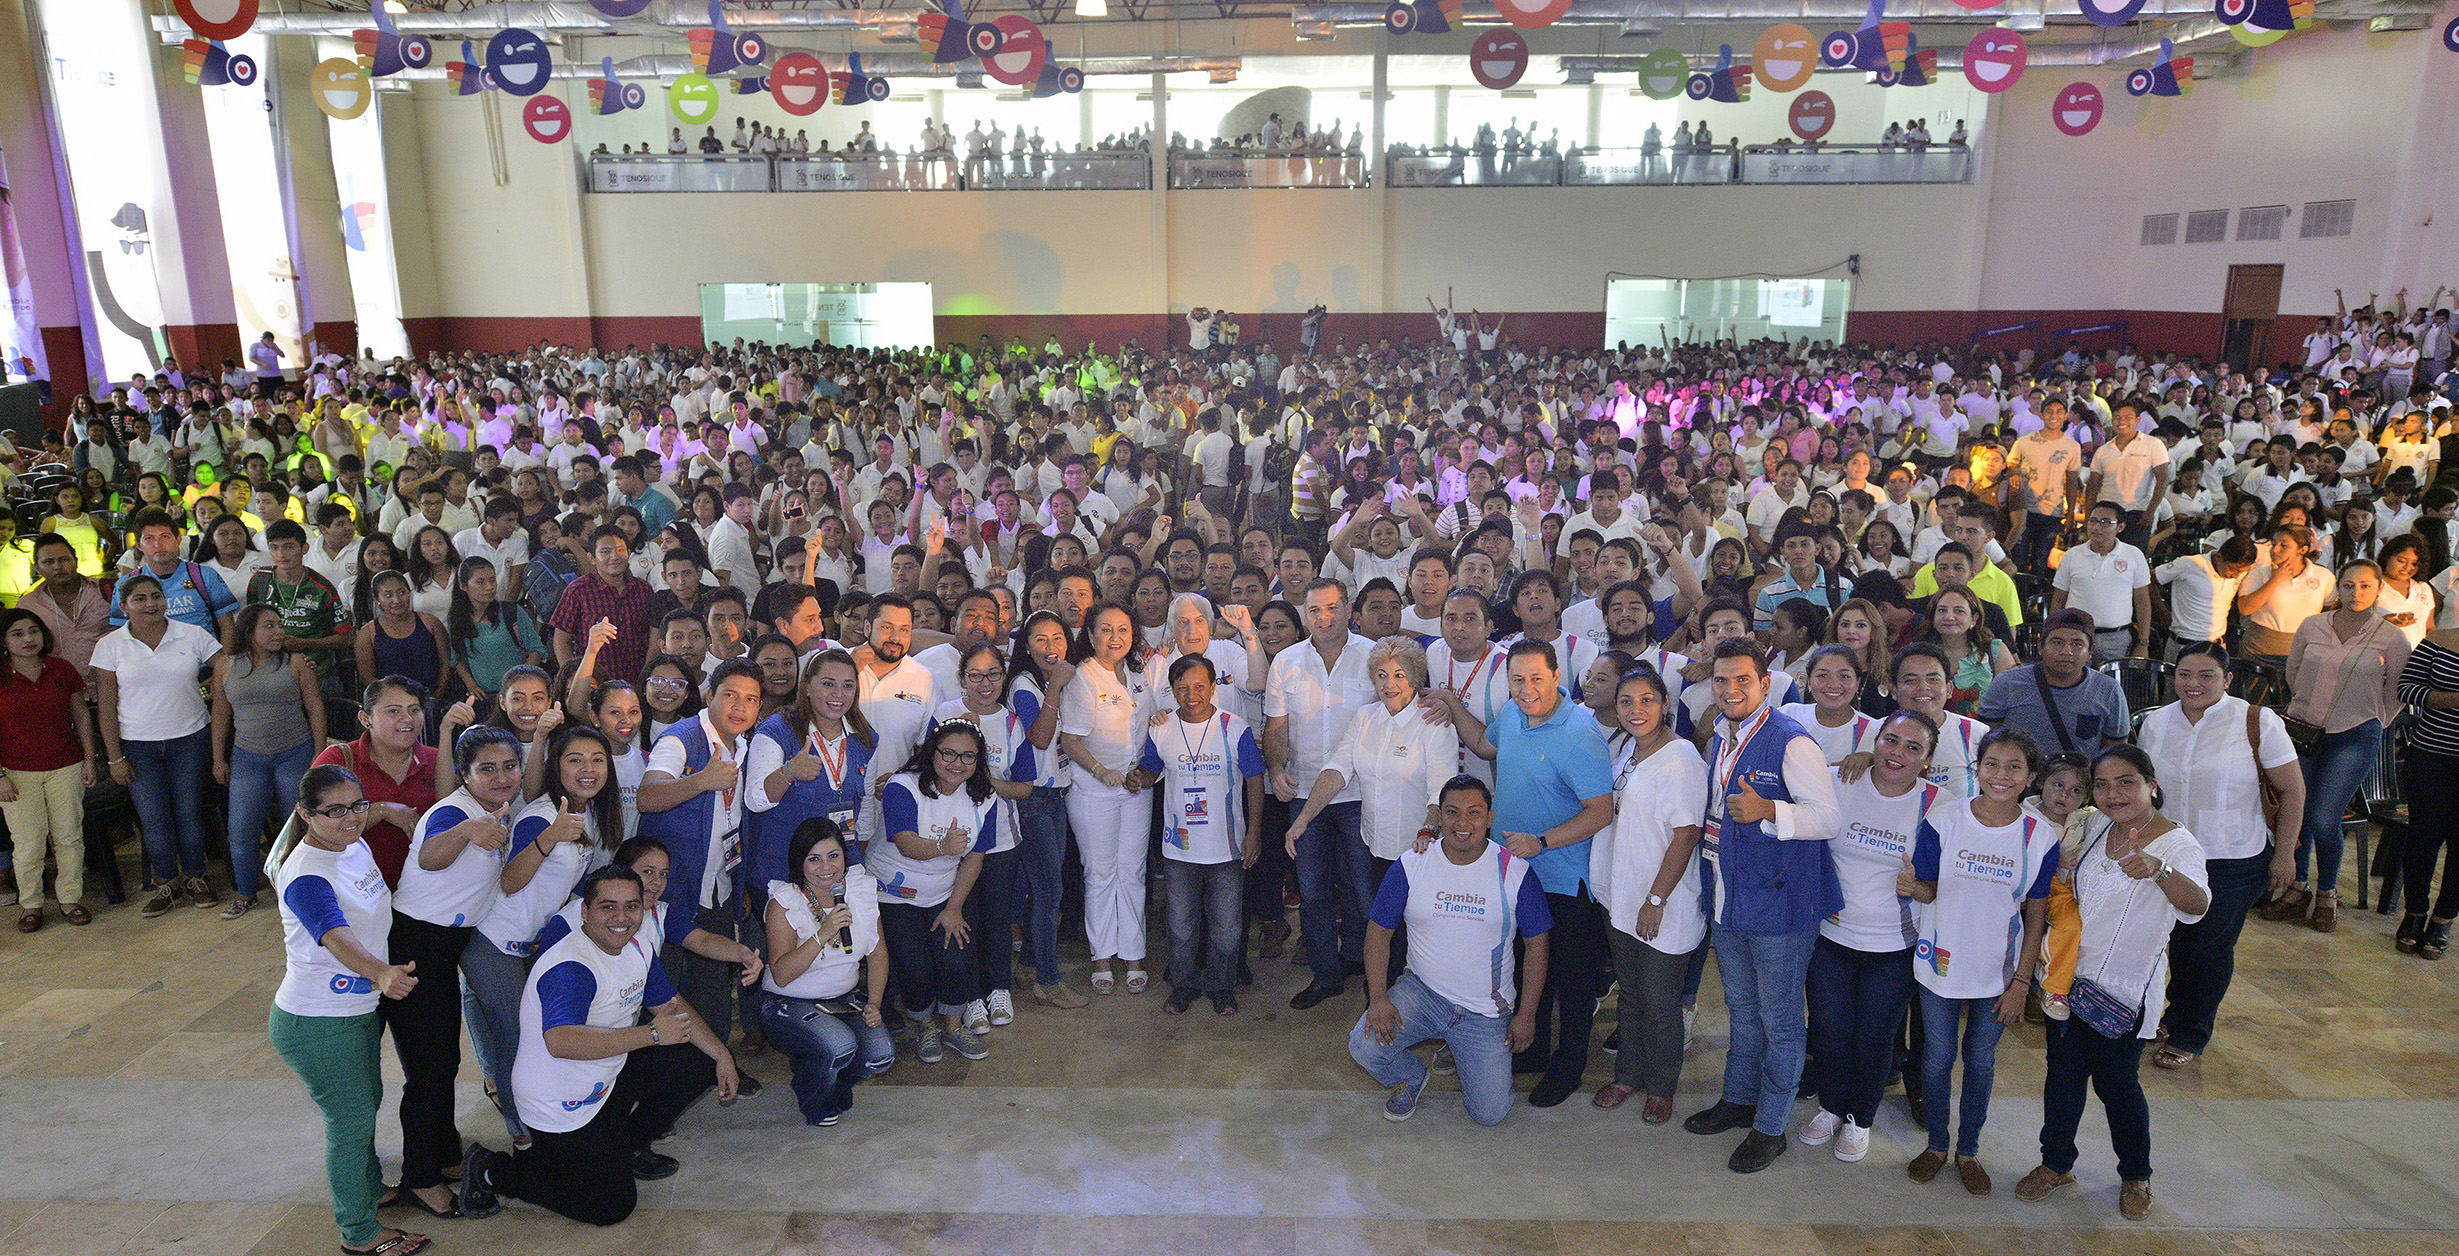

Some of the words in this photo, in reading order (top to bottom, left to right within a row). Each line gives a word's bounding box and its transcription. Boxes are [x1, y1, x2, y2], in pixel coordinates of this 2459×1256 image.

[1849, 821, 1908, 843] Cambia
[1846, 832, 1856, 840] tu
[1858, 832, 1906, 853] Tiempo
[1957, 849, 2015, 868] Cambia
[354, 868, 380, 891] Cambia
[1955, 861, 1965, 869] tu
[1967, 861, 2013, 879] Tiempo
[1436, 891, 1486, 905] Cambia
[1444, 902, 1485, 915] Tiempo
[619, 979, 644, 999] Cambia
